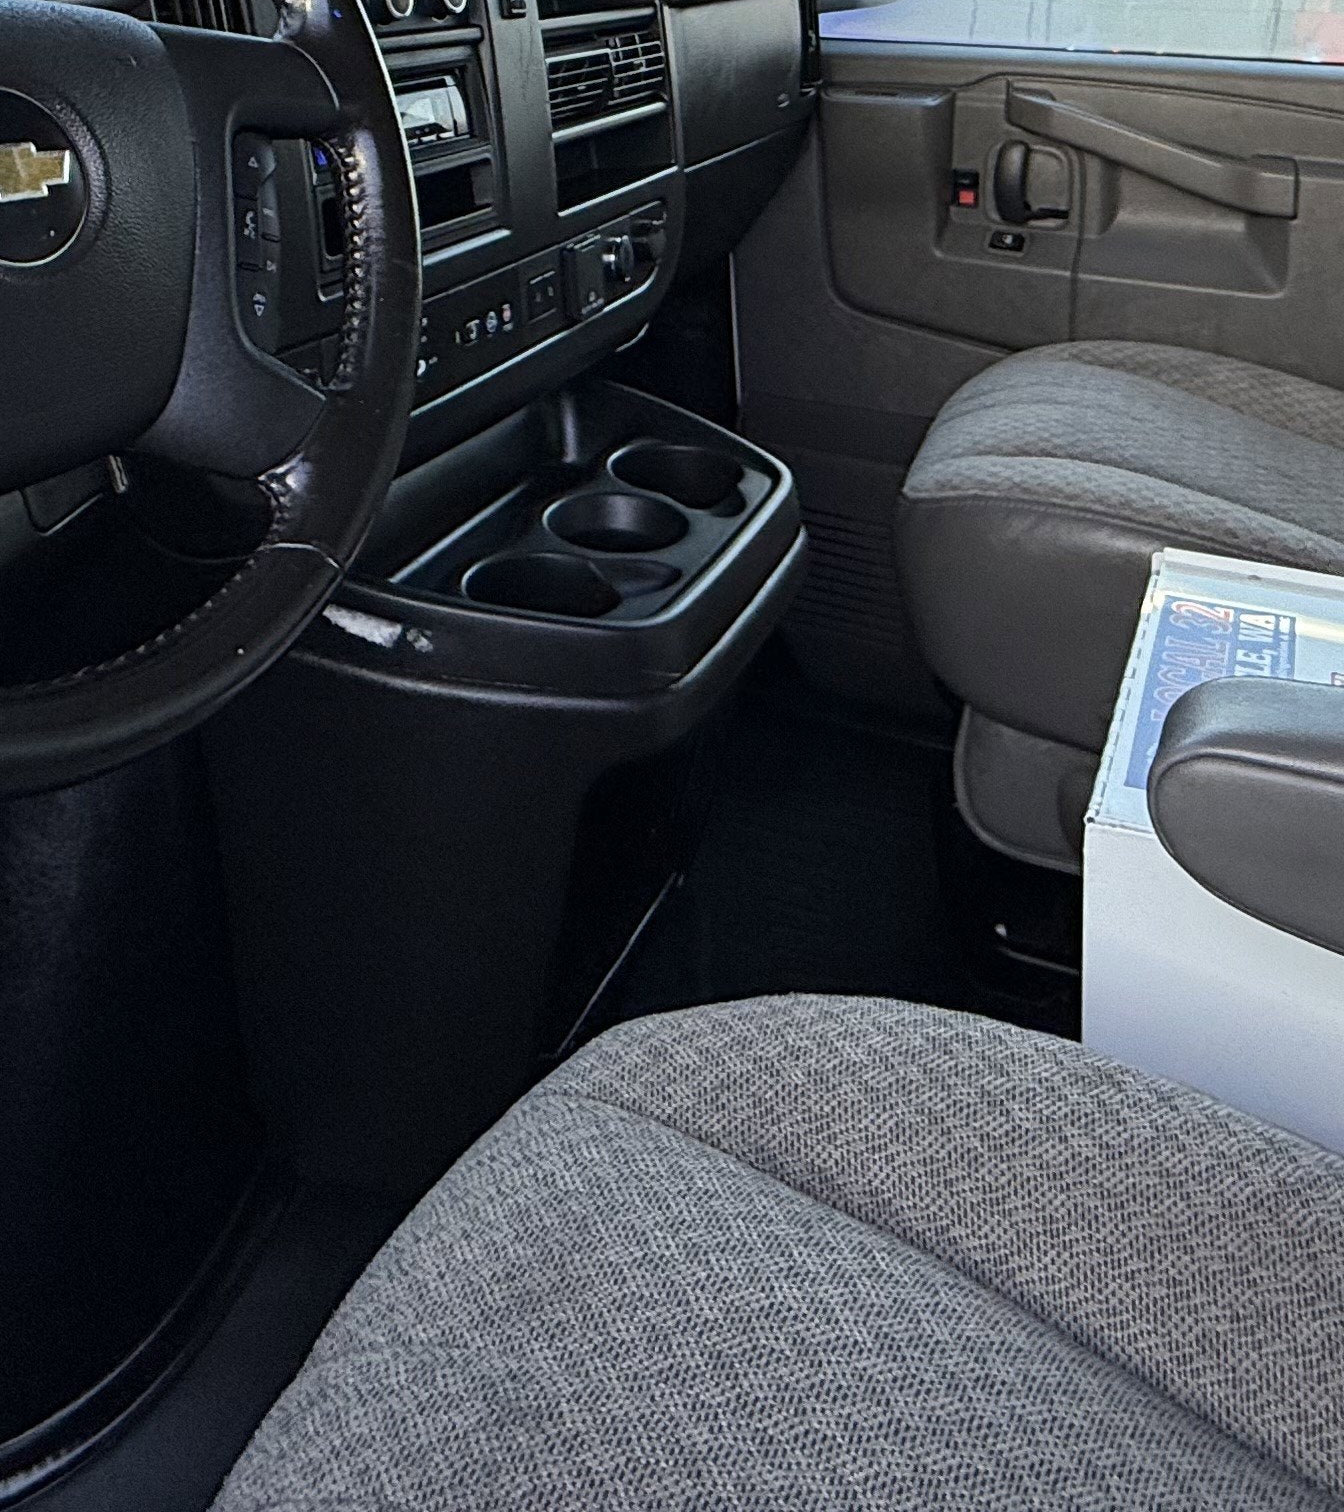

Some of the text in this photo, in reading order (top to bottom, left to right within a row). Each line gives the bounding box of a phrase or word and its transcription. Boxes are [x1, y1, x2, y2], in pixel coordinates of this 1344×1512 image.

[1151, 601, 1234, 721] OCAL 32
[1238, 614, 1276, 643] WA
